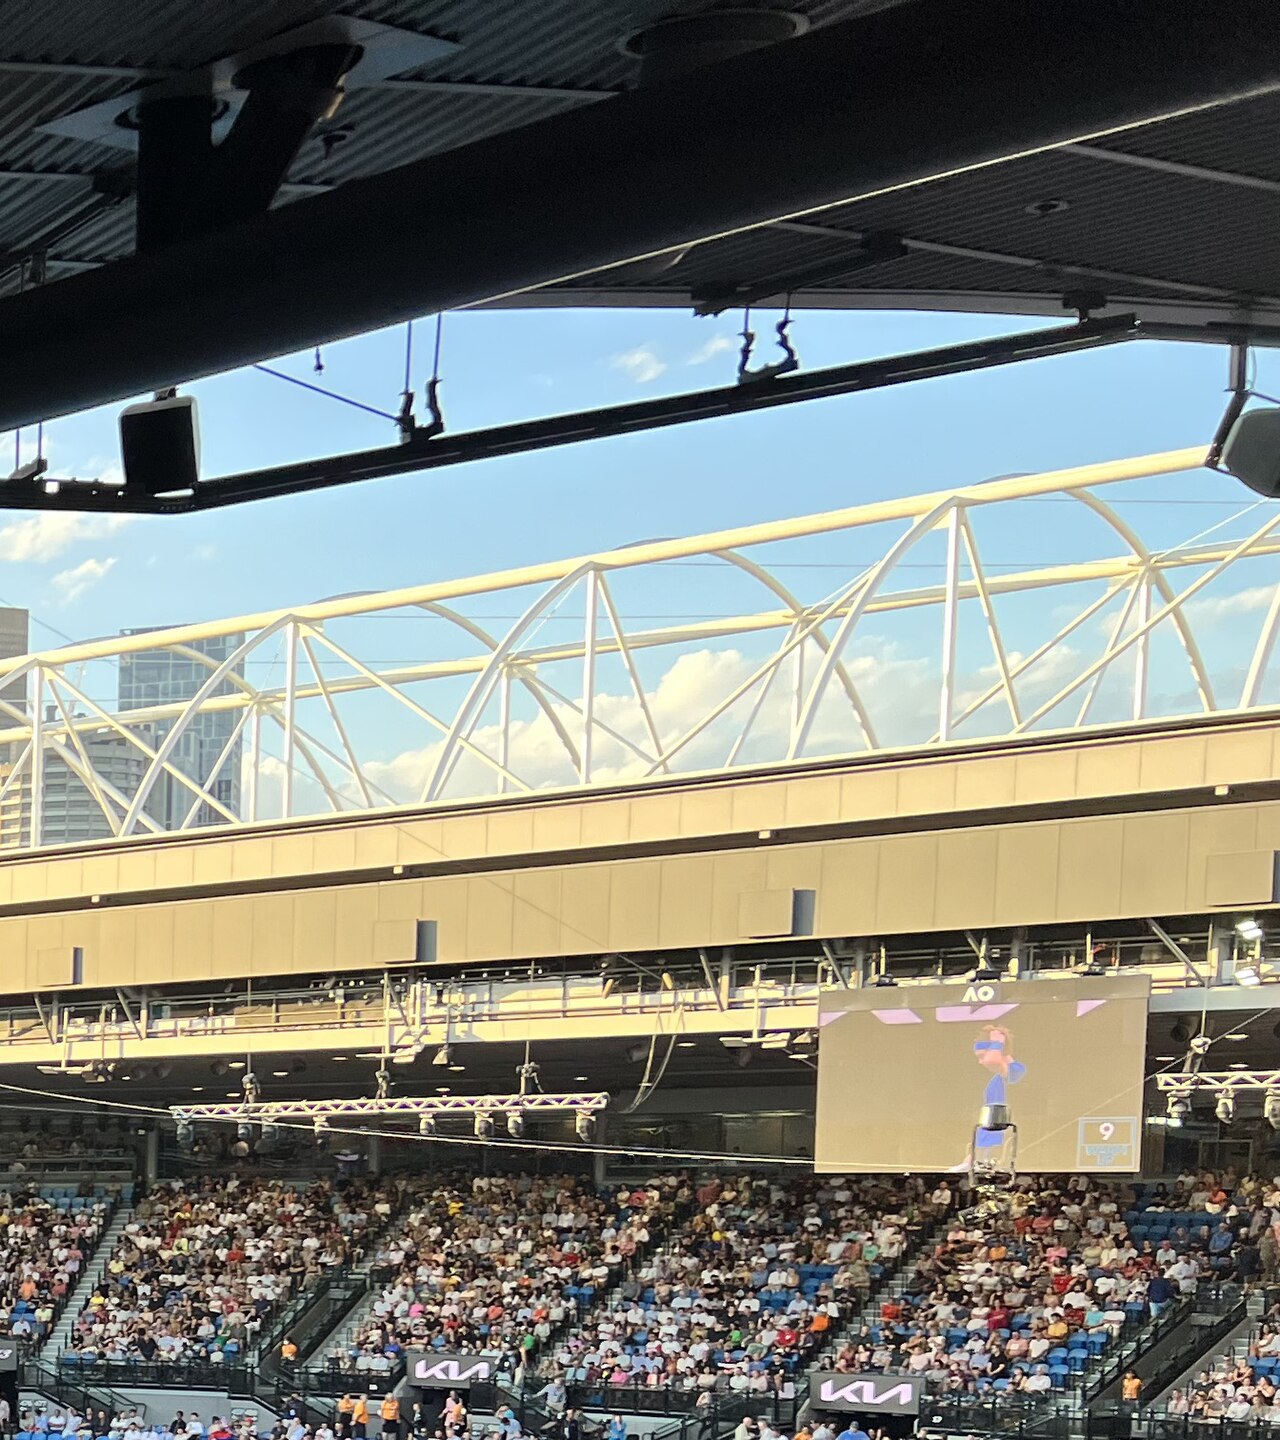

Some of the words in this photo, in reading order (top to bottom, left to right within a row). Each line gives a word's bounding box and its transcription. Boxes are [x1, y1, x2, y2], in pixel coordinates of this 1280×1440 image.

[961, 986, 994, 1002] AO
[1099, 1122, 1115, 1141] 9
[414, 1359, 490, 1381] KIA
[820, 1379, 913, 1405] KIA
